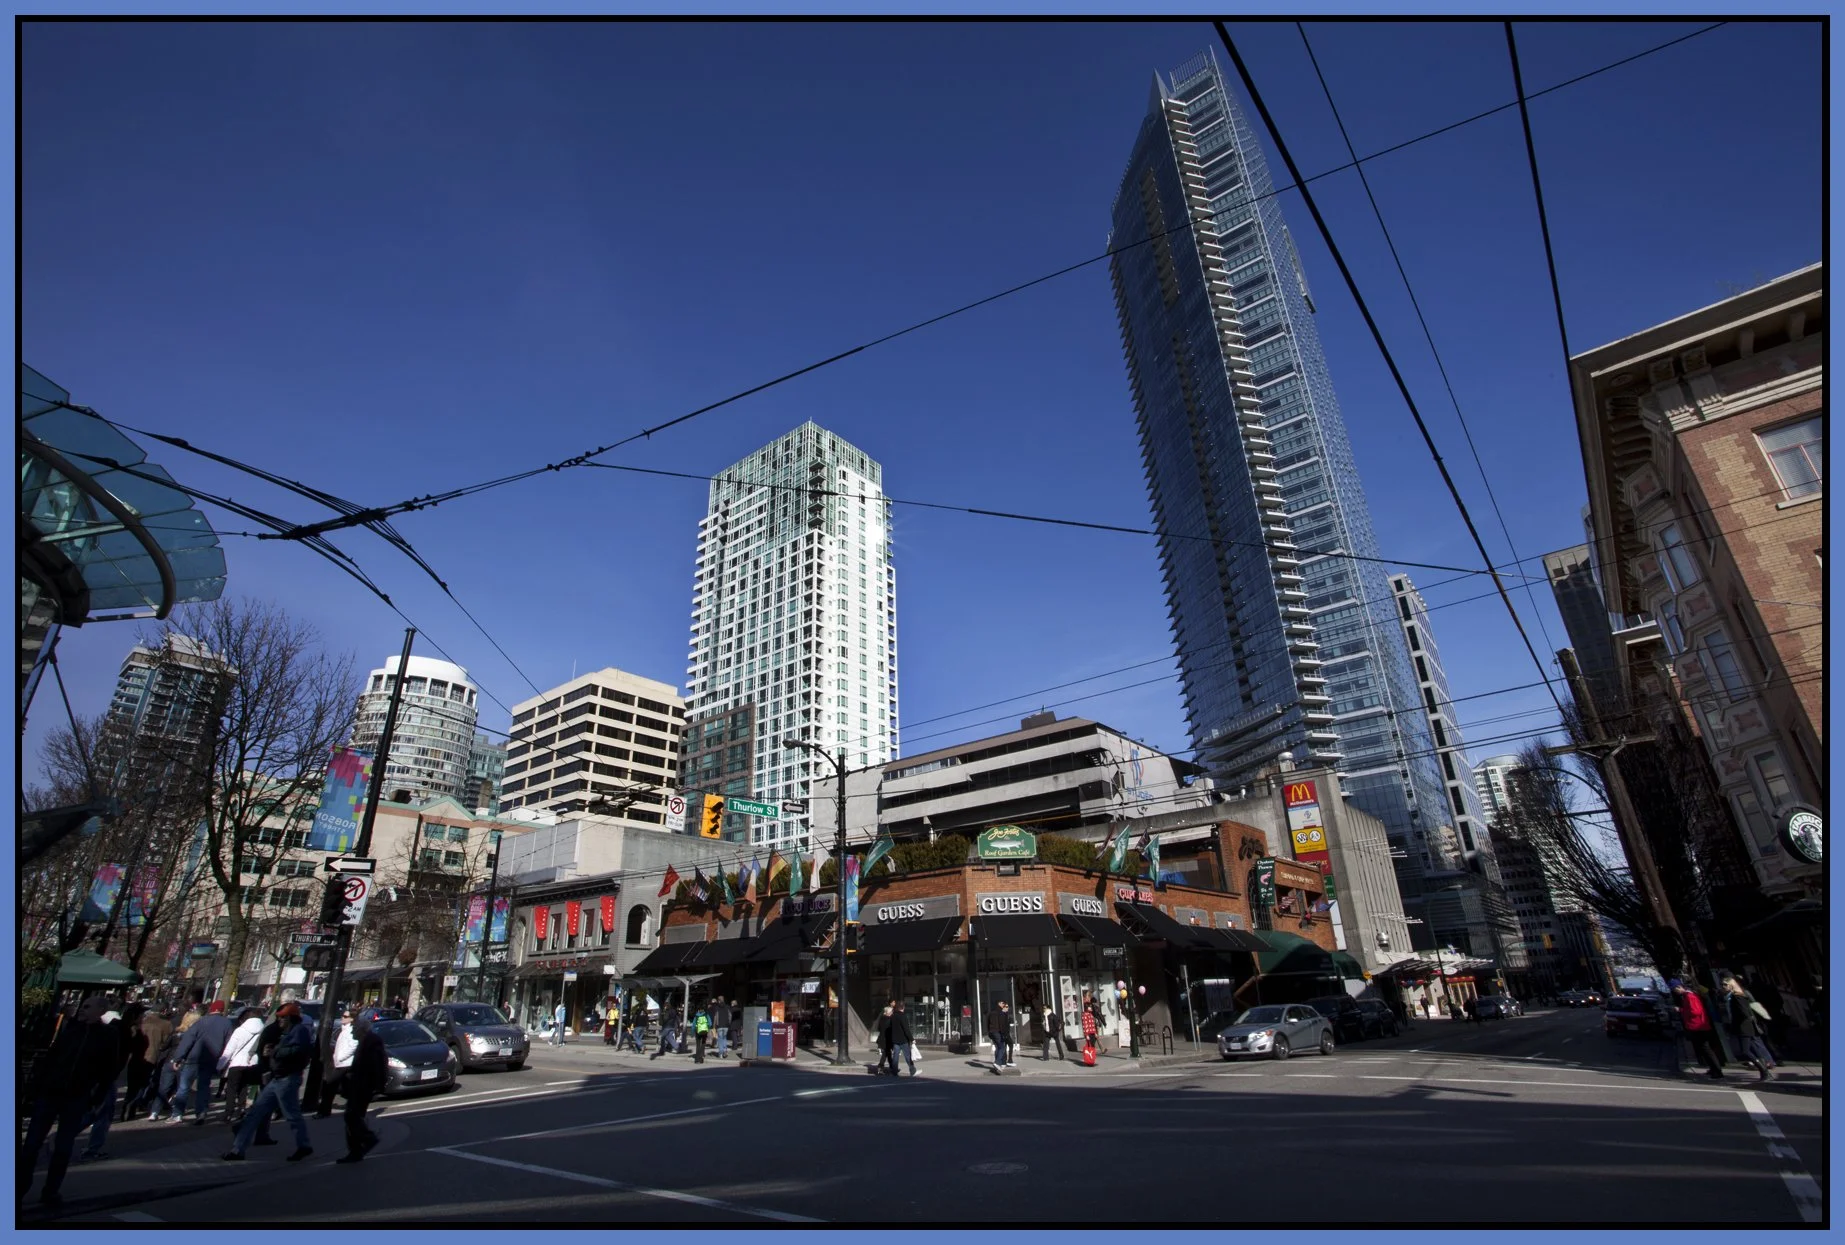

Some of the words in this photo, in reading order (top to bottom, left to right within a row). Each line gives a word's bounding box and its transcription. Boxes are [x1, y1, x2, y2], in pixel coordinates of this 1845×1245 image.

[732, 801, 763, 813] Thurlow
[766, 806, 776, 815] St
[984, 849, 997, 857] Roof
[981, 896, 1042, 912] GUESS
[1072, 898, 1102, 914] GUESS
[878, 903, 925, 921] GUESS
[295, 934, 322, 943] THURLOW
